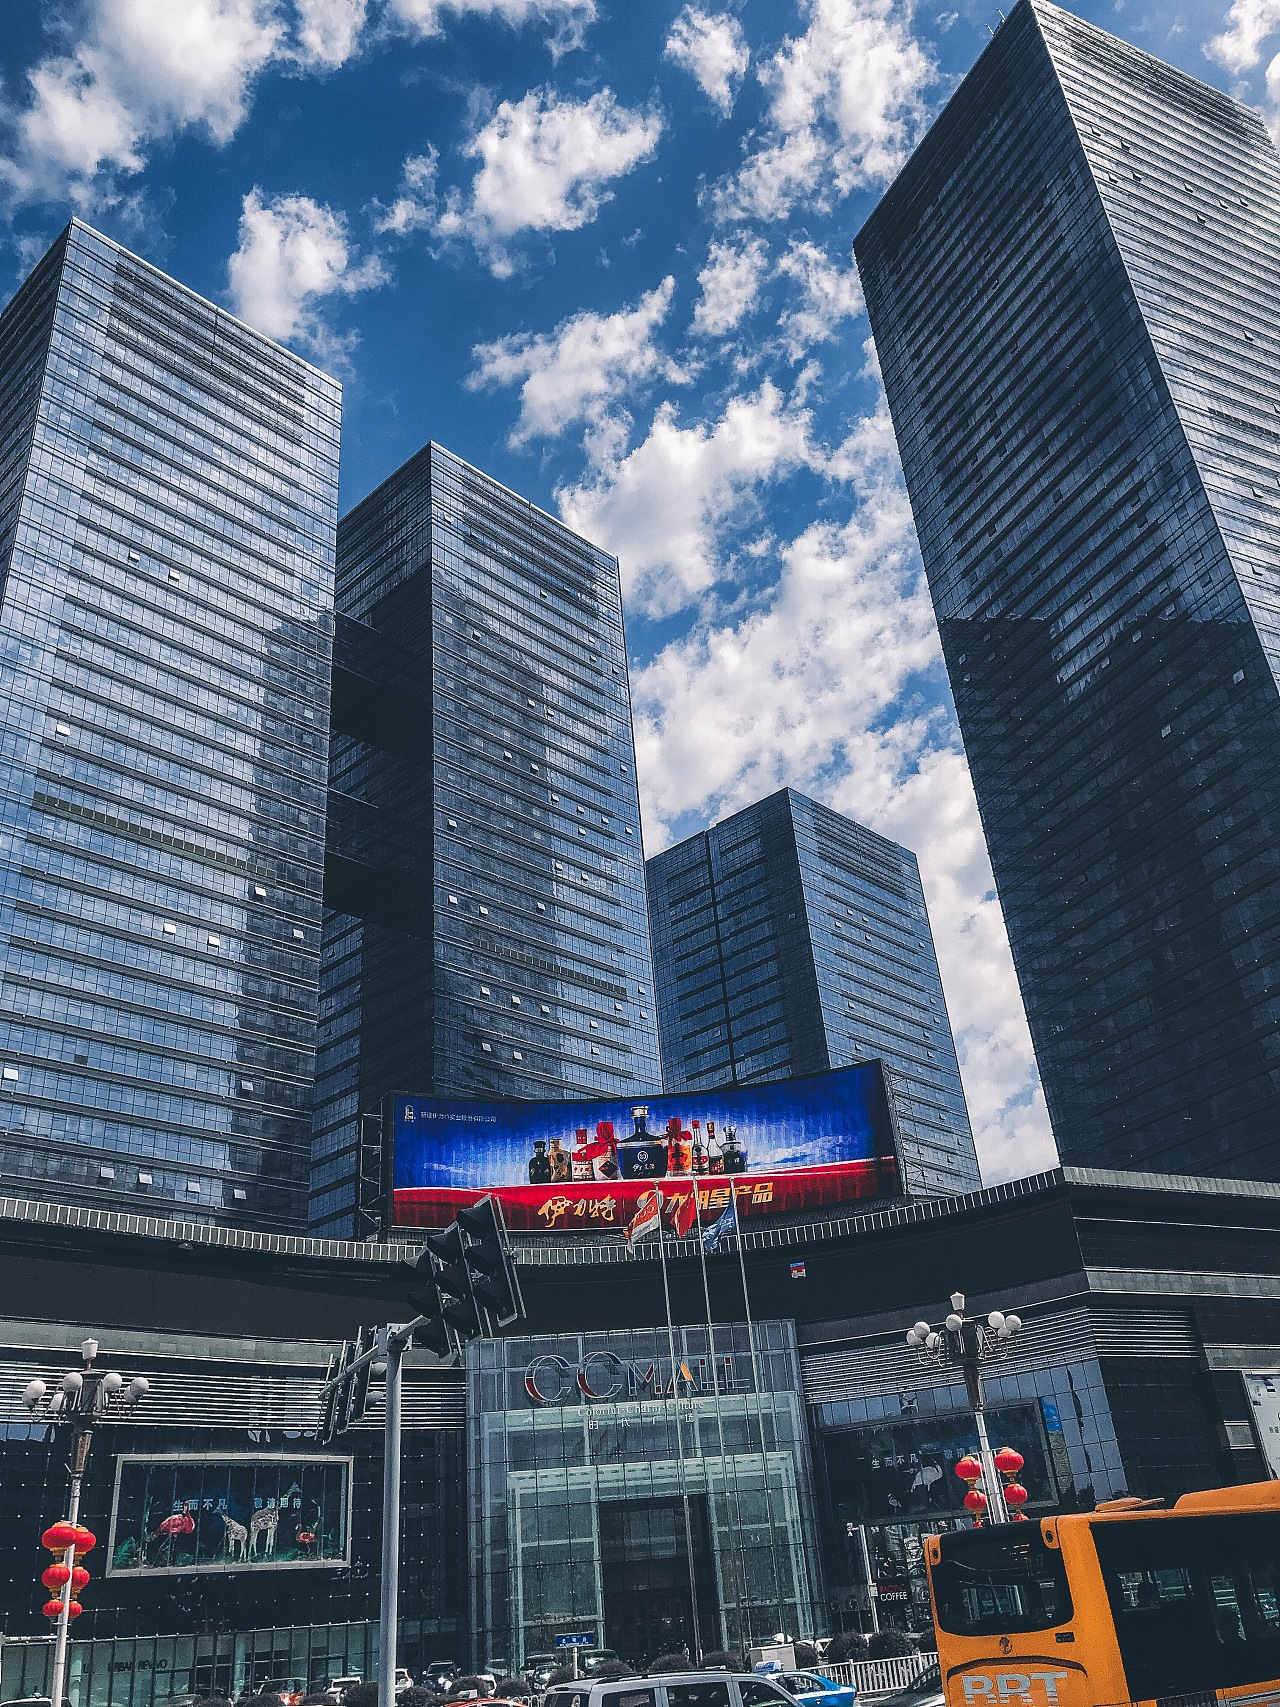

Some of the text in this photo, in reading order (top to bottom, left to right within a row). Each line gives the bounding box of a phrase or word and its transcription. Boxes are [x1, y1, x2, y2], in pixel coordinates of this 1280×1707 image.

[525, 1351, 750, 1402] CCMALL
[880, 1584, 905, 1593] PACIFIC
[880, 1591, 908, 1602] COFFEE
